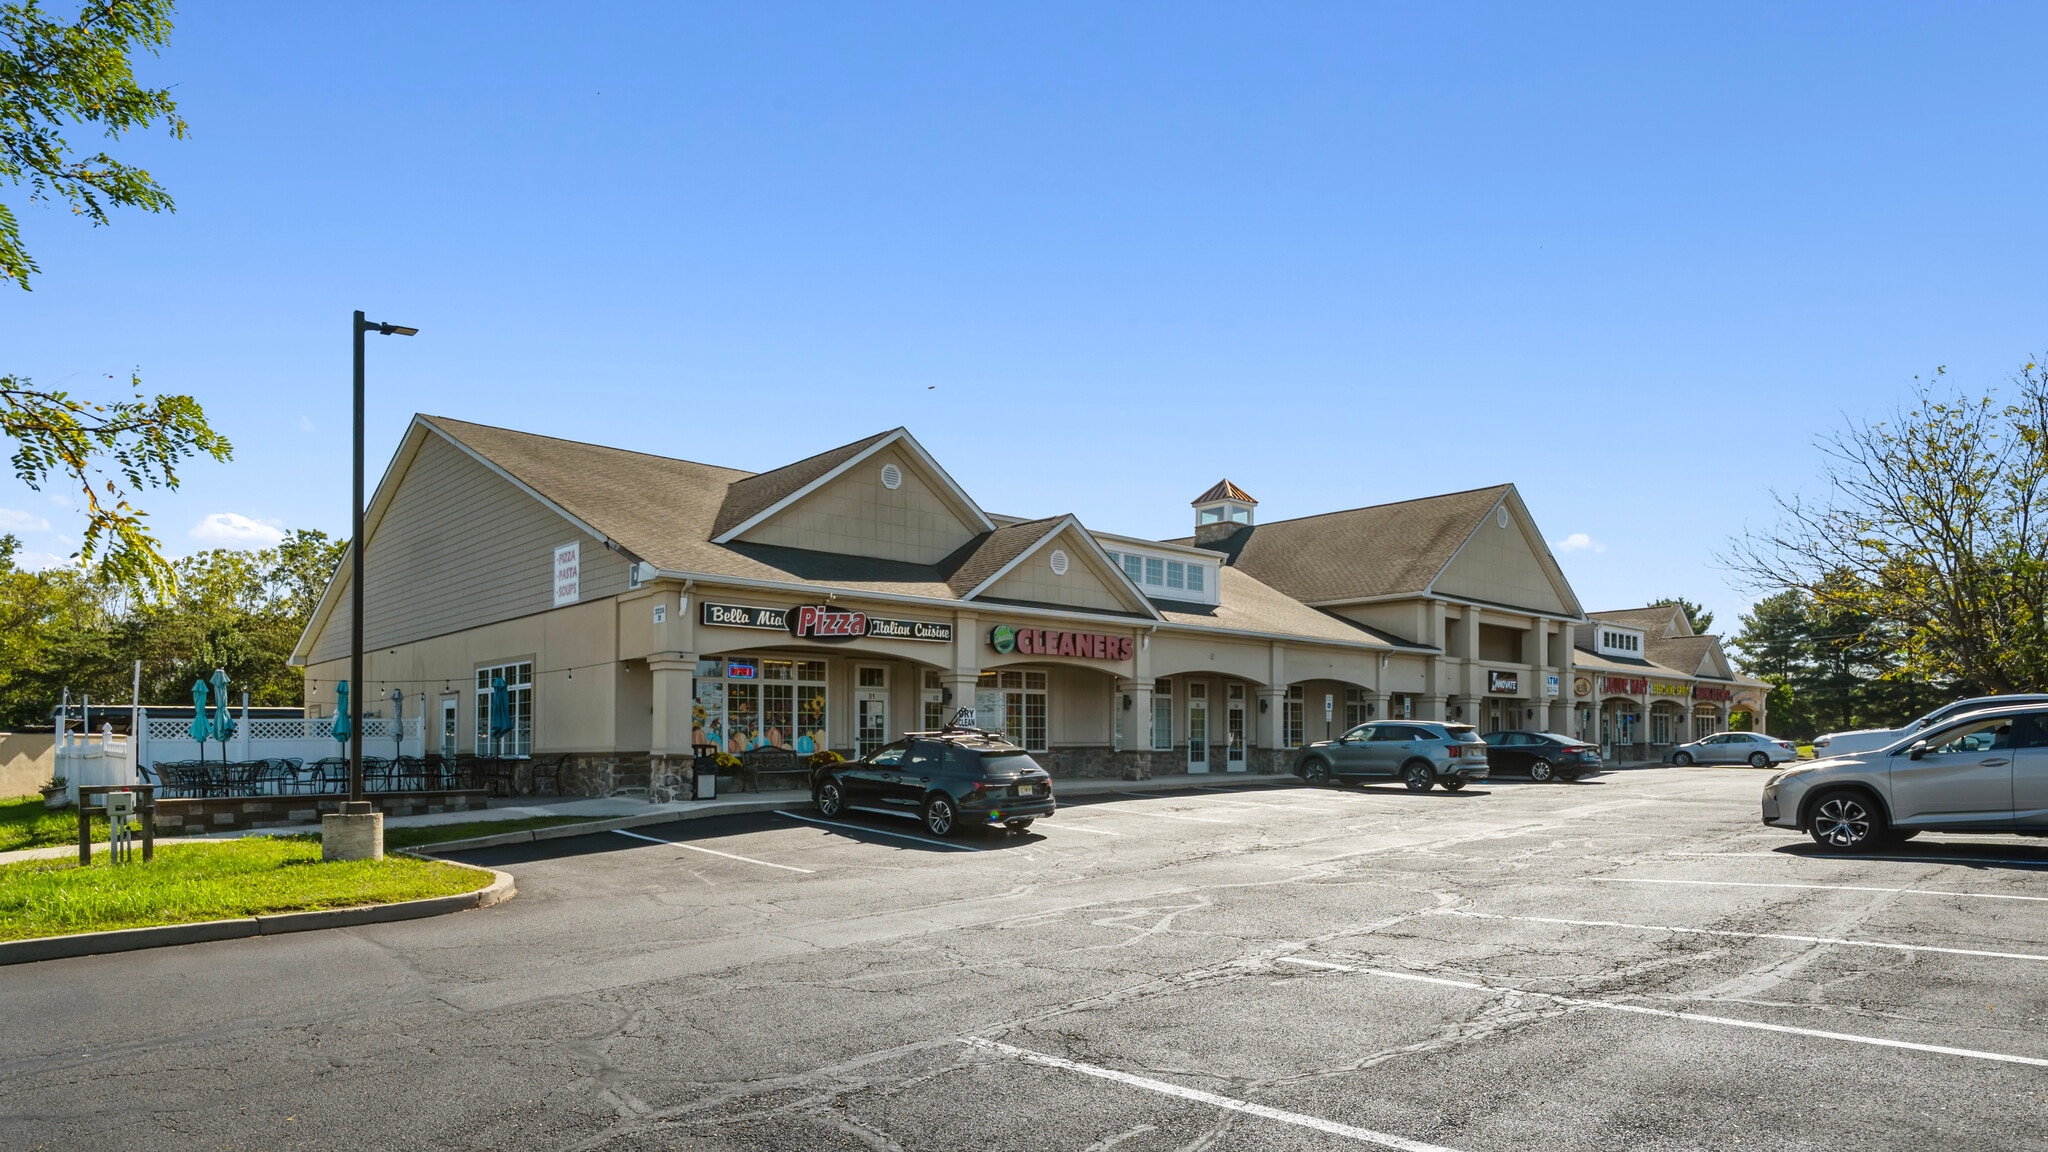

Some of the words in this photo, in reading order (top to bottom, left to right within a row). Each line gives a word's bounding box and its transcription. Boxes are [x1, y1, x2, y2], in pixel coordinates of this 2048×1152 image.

[558, 550, 576, 565] PIZZA
[558, 566, 577, 581] PASTA
[558, 583, 577, 597] SOUPS
[711, 606, 750, 623] Bella
[756, 610, 783, 626] Mia
[797, 605, 867, 637] Pizza
[873, 620, 911, 636] Italian
[915, 623, 950, 639] Cuisine
[1016, 628, 1133, 661] CLEANERS
[730, 667, 753, 677] OPEN
[958, 718, 975, 727] CLEAN
